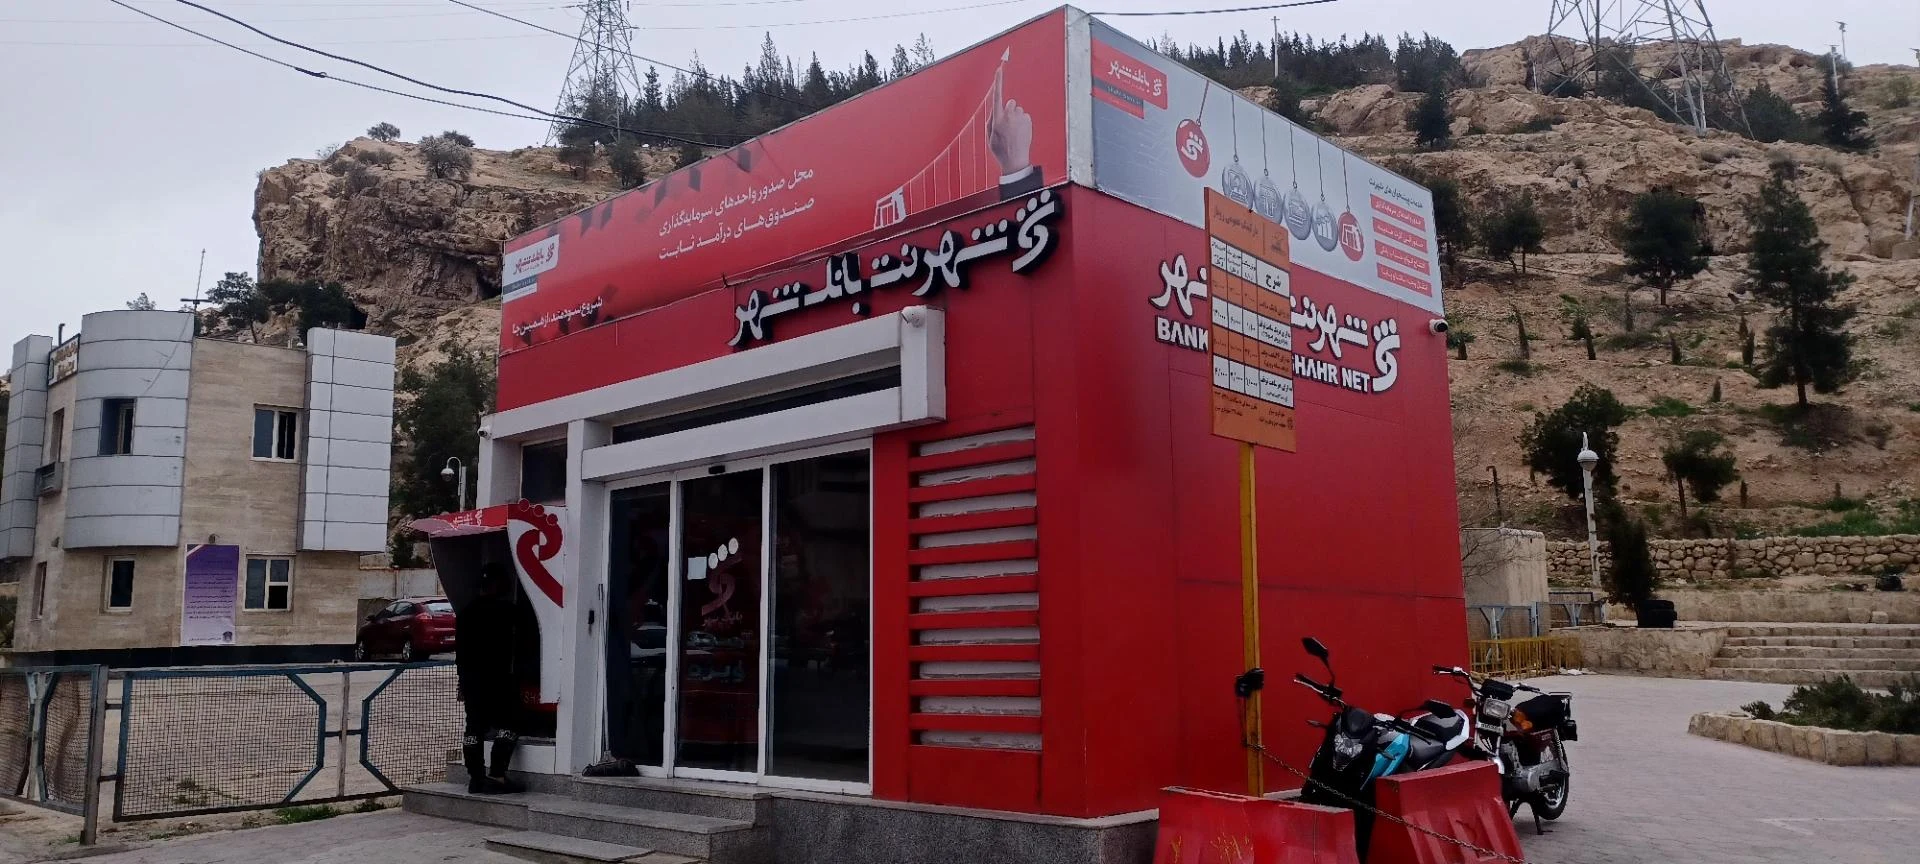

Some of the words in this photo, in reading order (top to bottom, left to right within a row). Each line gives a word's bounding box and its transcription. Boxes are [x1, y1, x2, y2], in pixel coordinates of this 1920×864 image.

[1107, 60, 1132, 80] شهر
[1131, 68, 1150, 93] بانک
[757, 178, 785, 201] صدور
[788, 168, 814, 190] محل
[715, 186, 757, 216] واحدهای
[659, 234, 695, 260] ثابت
[697, 222, 731, 248] درآمد
[804, 253, 862, 315] بانک
[1266, 276, 1281, 290] شرح
[580, 296, 603, 317] شروع
[728, 282, 800, 346] شهر
[1157, 317, 1208, 351] BANK
[1291, 355, 1338, 386] HAHR
[1342, 370, 1371, 393] NET
